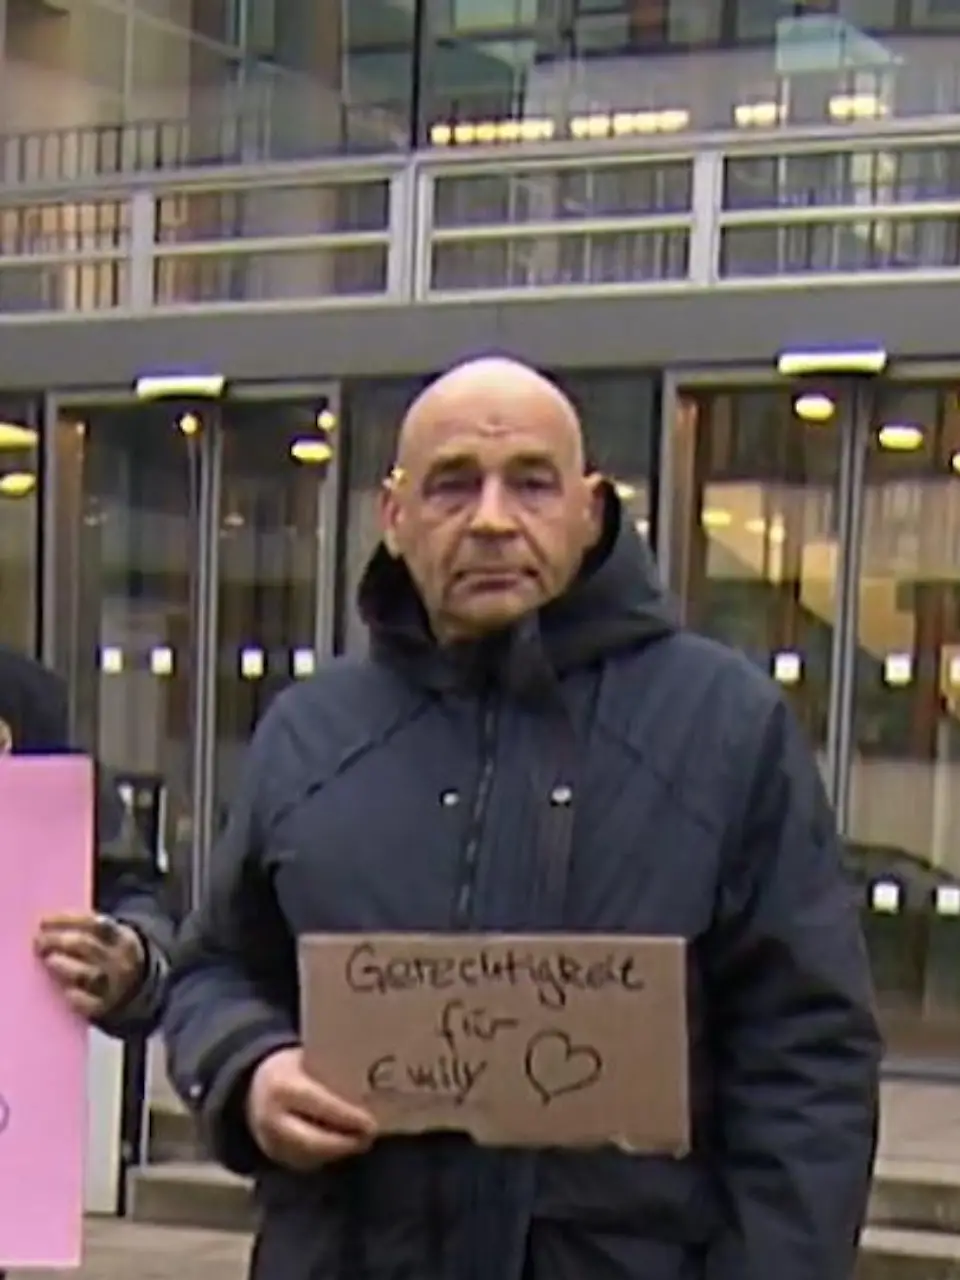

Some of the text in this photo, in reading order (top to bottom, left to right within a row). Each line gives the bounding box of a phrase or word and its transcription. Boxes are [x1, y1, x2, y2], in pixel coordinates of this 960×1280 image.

[344, 942, 645, 1007] Gerechtigkeit
[437, 998, 518, 1052] für
[366, 1055, 488, 1106] Emily
